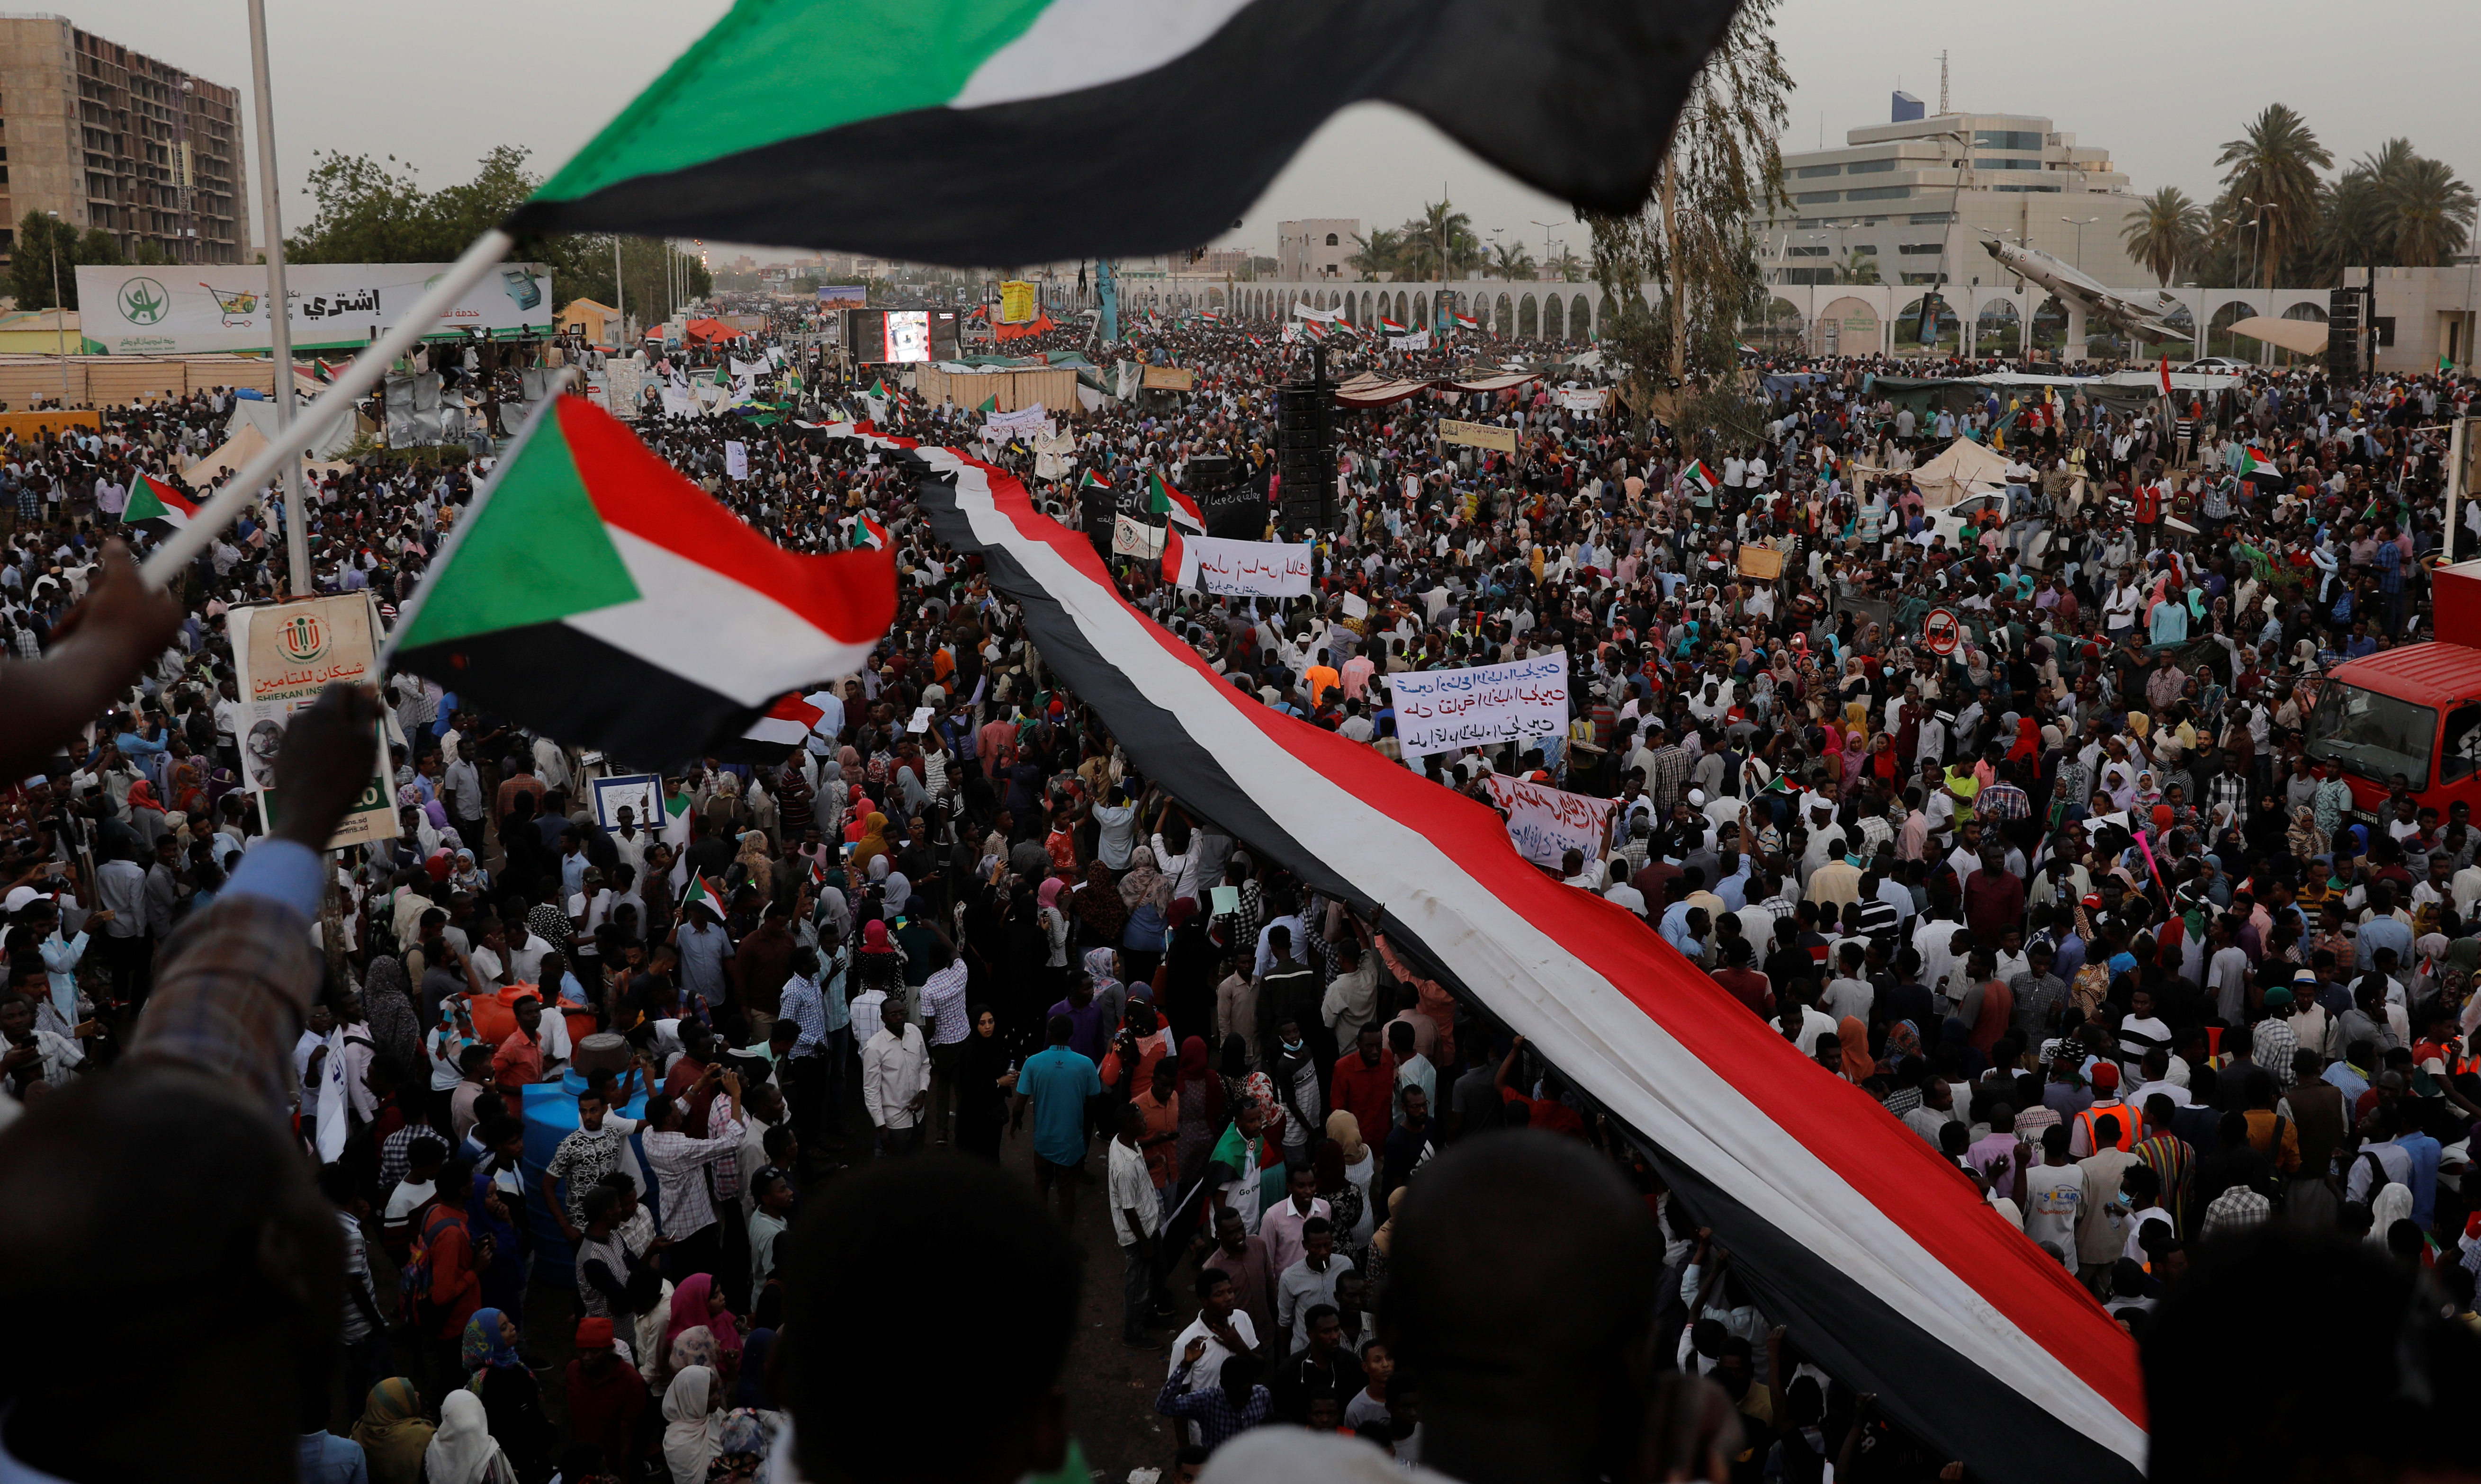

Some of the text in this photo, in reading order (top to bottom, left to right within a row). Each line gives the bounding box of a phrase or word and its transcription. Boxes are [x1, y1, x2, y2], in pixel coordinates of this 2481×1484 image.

[304, 289, 381, 321] إشتري
[456, 309, 479, 318] خدمة
[254, 662, 366, 693] شيكان للتأمين
[256, 679, 367, 702] SHIEKAN INSNCE
[2351, 809, 2378, 825] BISHI
